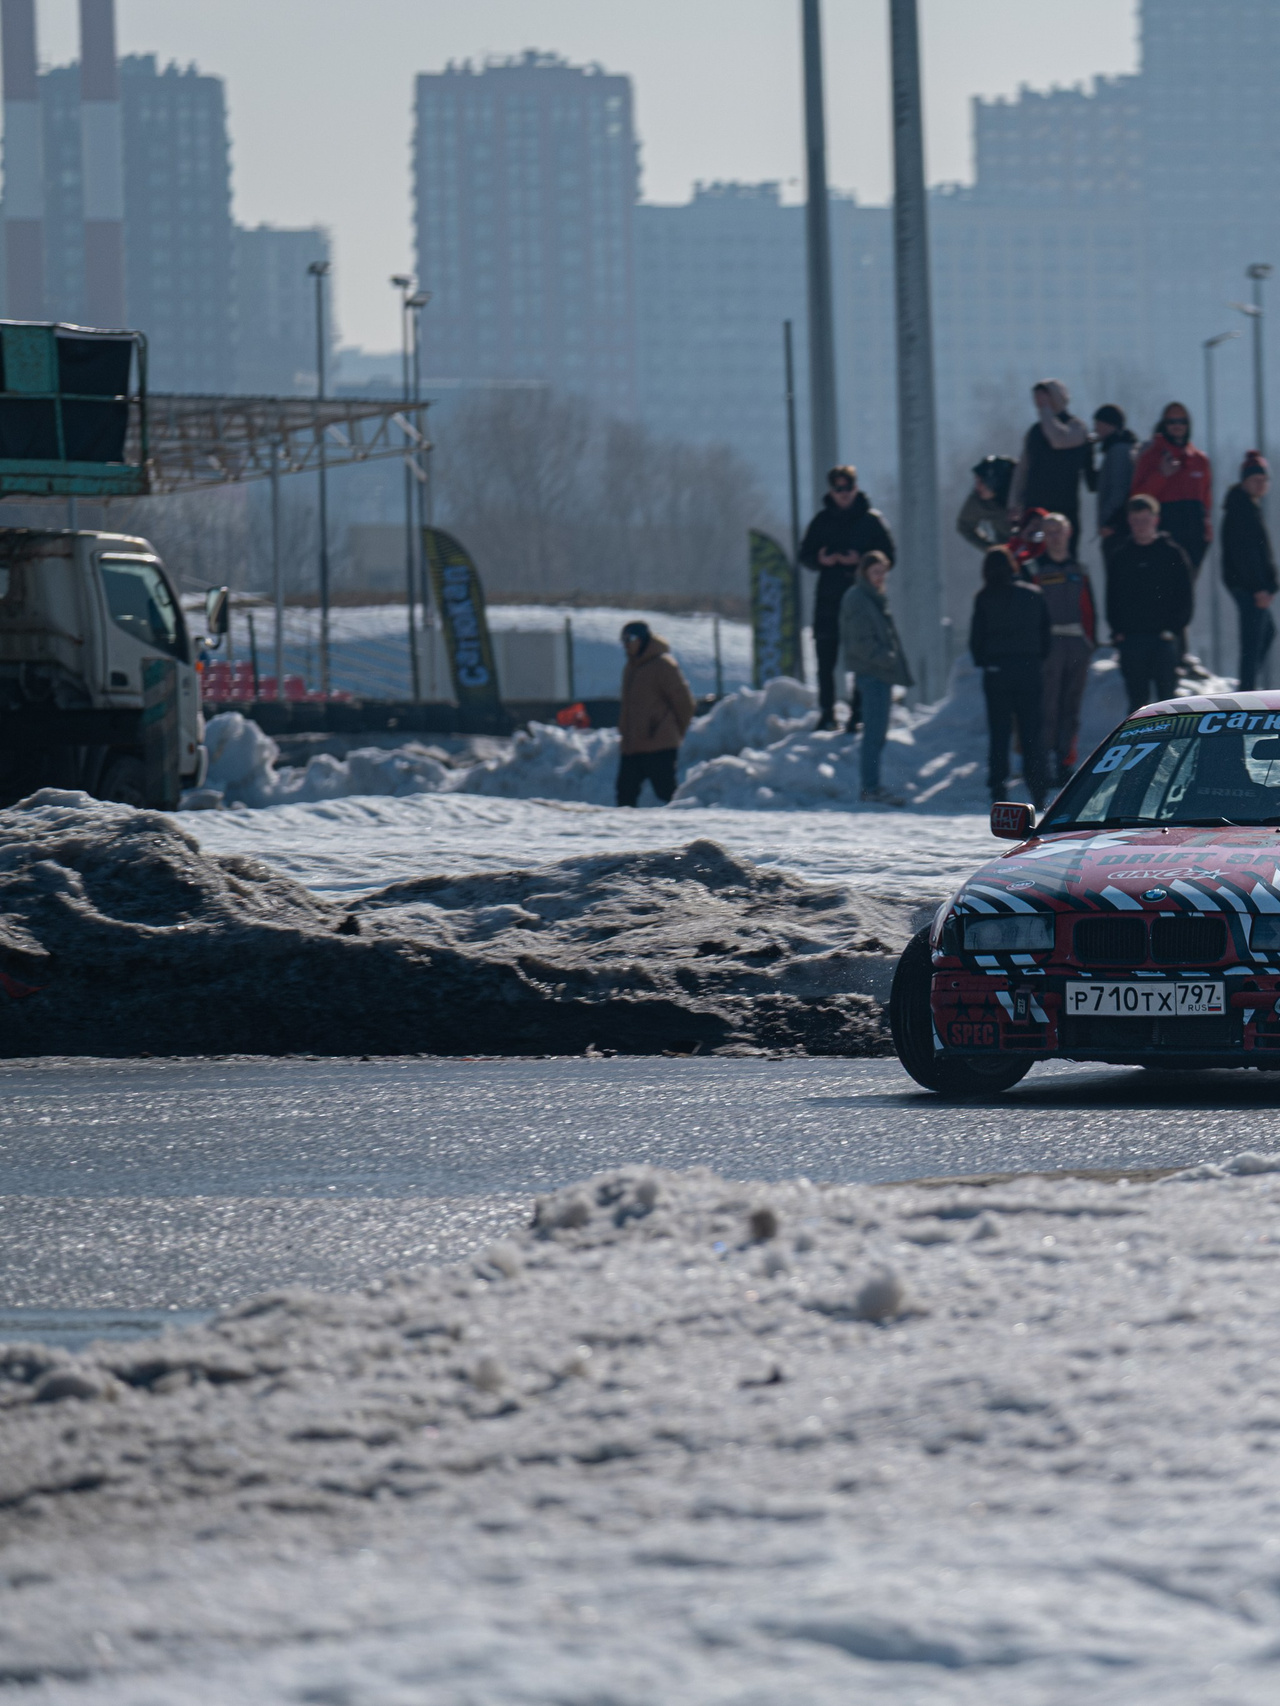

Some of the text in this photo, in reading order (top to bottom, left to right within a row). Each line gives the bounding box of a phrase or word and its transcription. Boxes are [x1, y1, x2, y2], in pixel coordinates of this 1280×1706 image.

[1092, 742, 1161, 773] 87
[1097, 851, 1218, 866] DRIFT
[1177, 984, 1216, 1004] 797
[1188, 1004, 1208, 1012] RUS
[951, 1024, 994, 1045] SPEC
